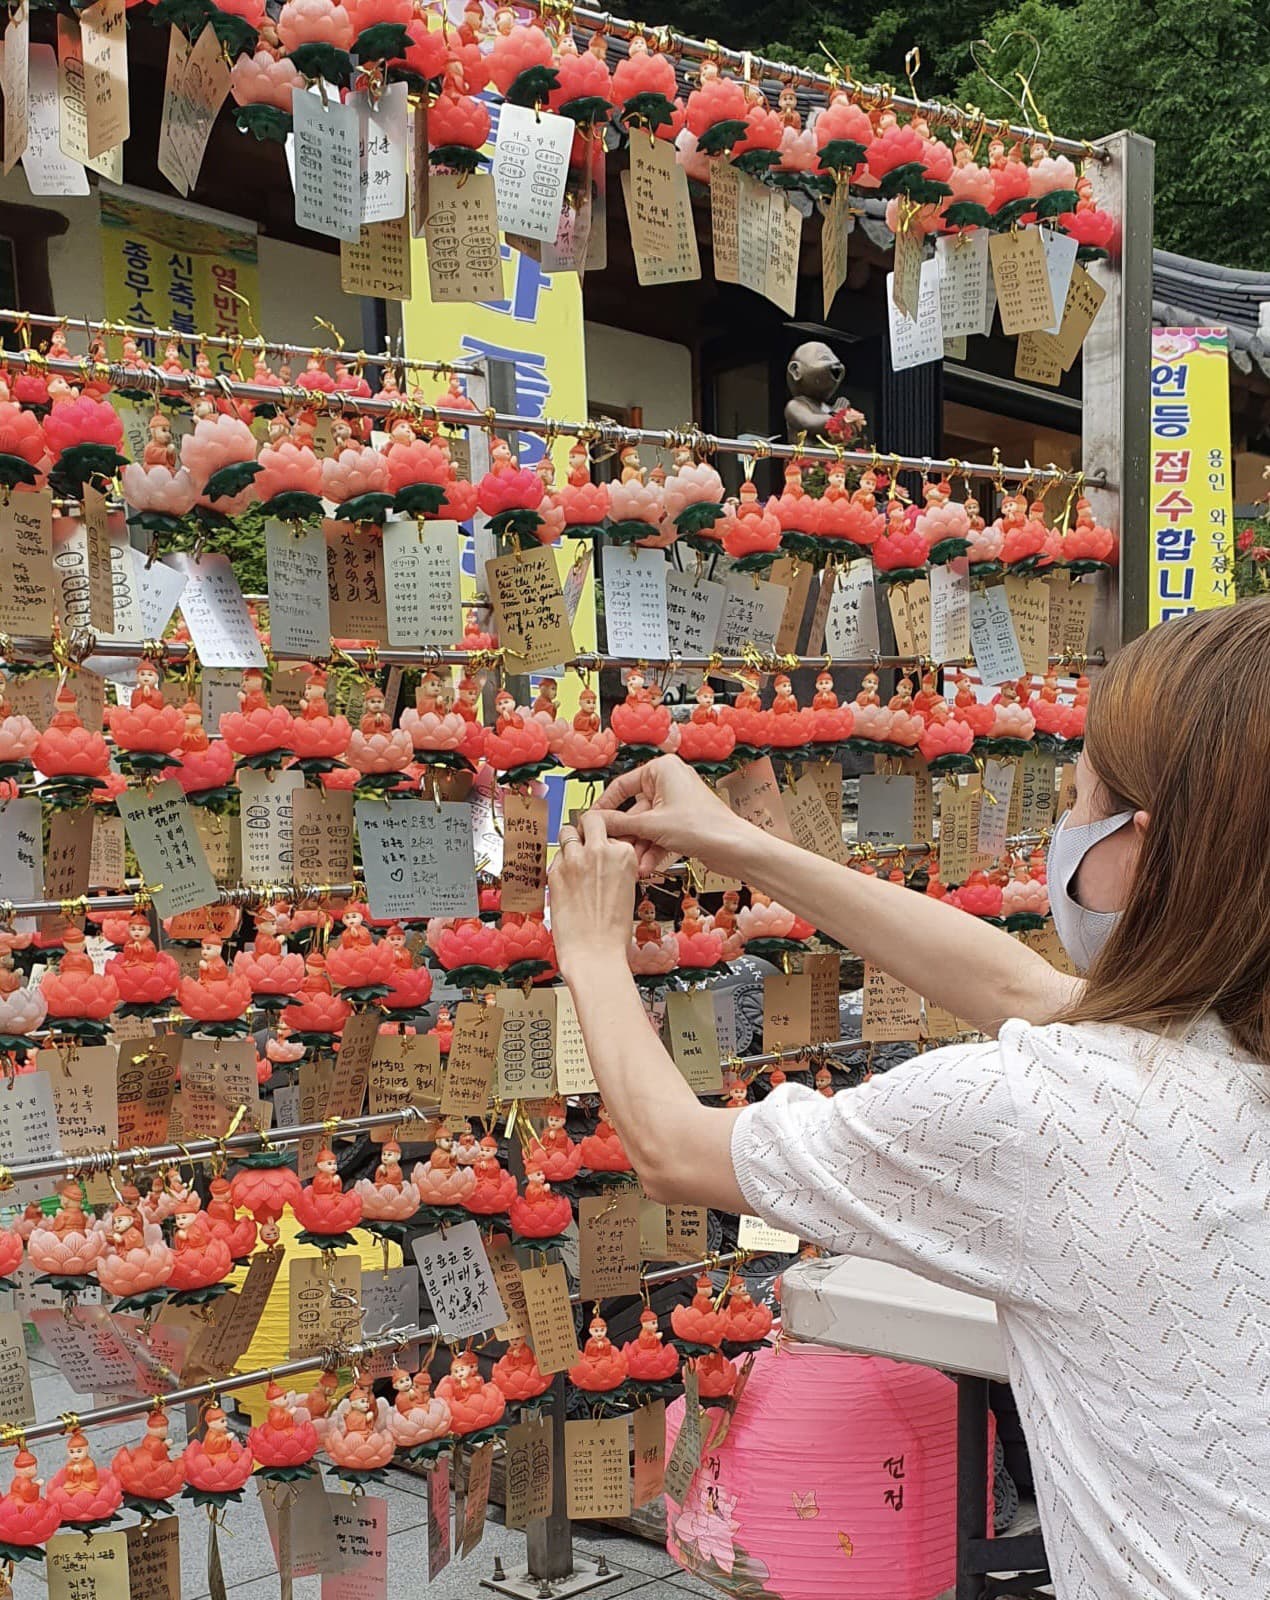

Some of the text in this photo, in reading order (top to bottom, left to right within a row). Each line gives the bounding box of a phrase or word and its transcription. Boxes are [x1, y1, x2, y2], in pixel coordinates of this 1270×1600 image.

[1151, 364, 1190, 438] 연등
[1207, 448, 1229, 597] 용인 와우정사
[883, 1455, 906, 1511] 선정
